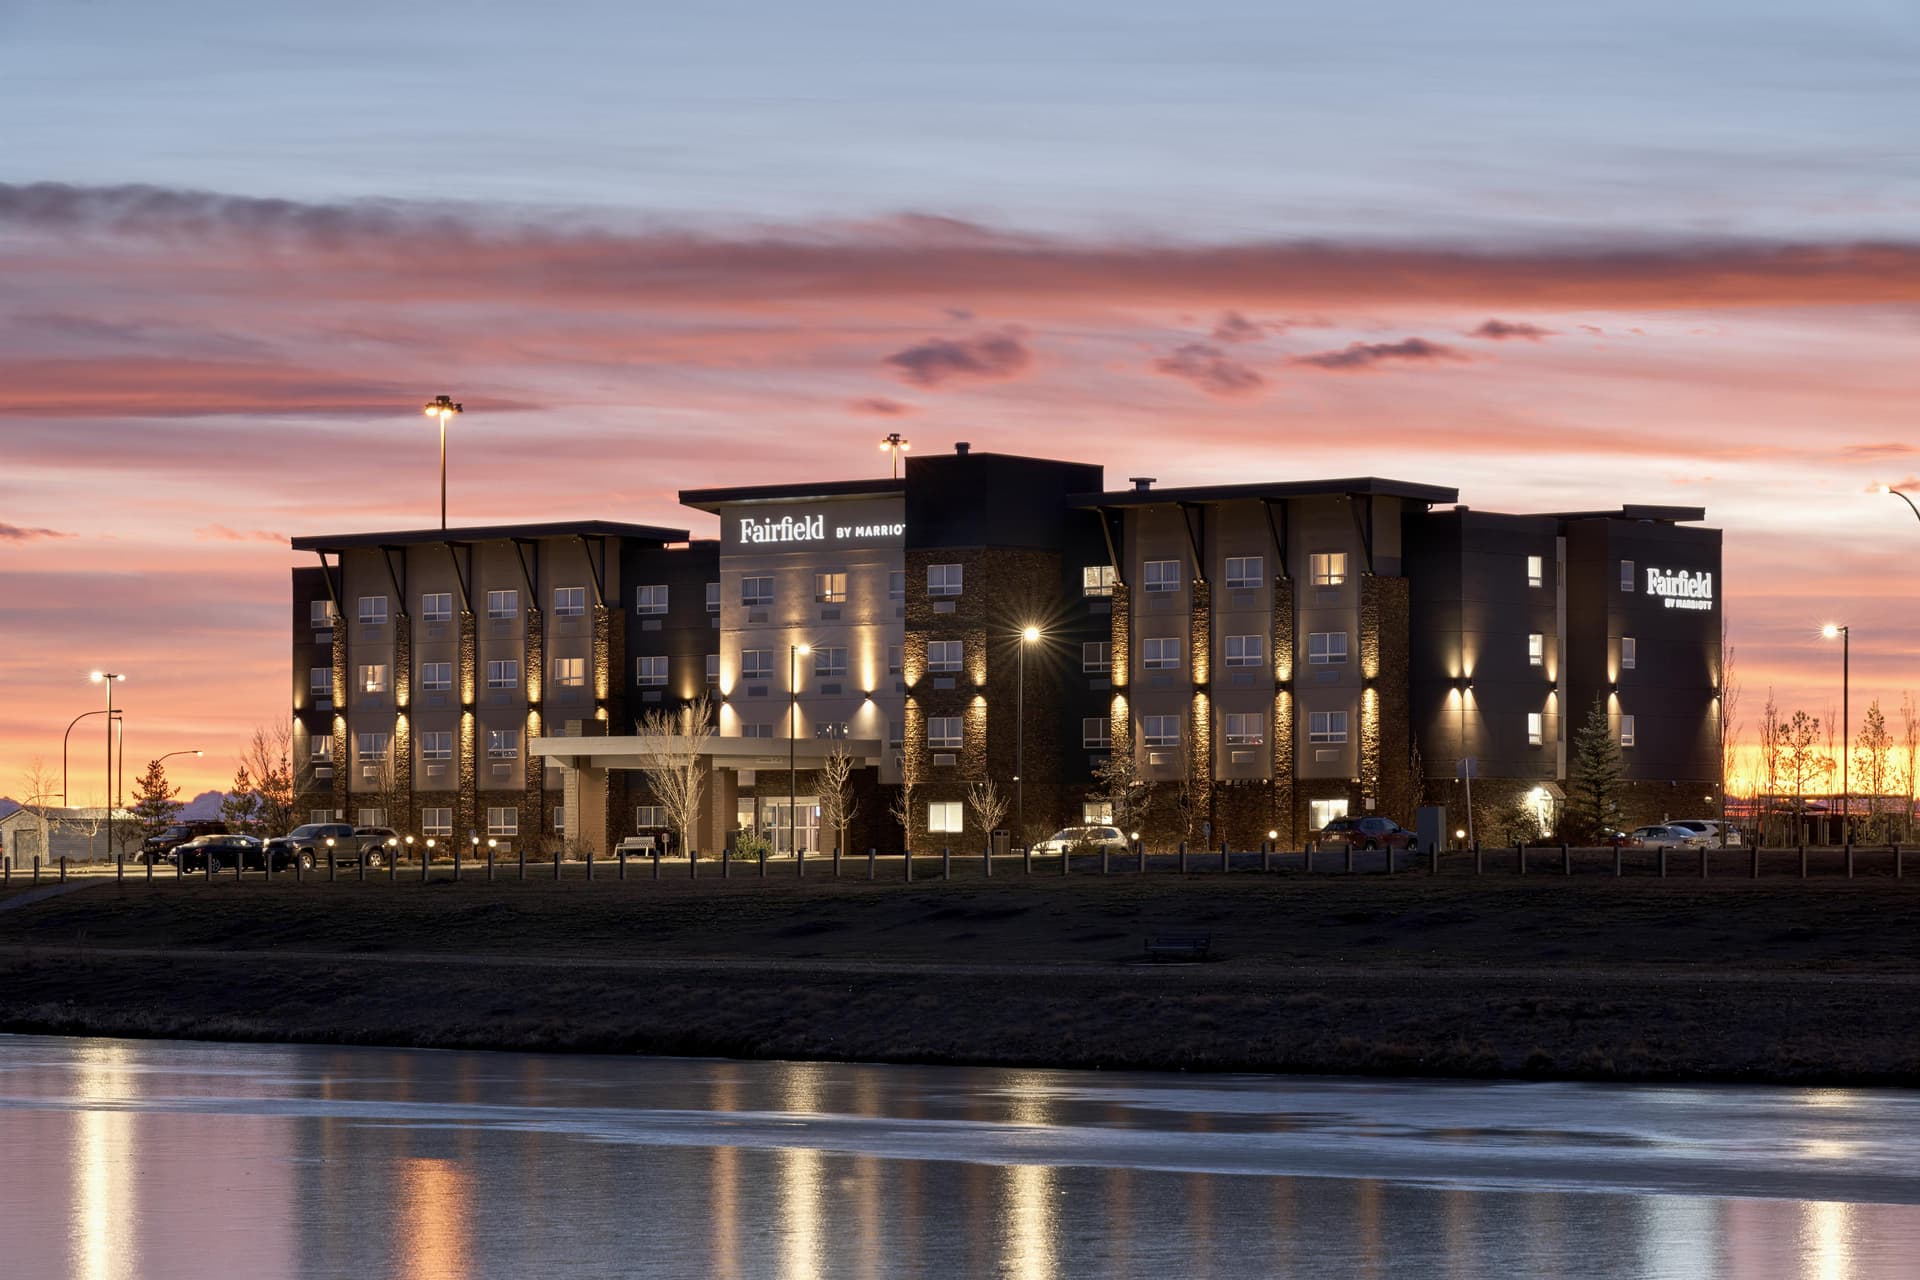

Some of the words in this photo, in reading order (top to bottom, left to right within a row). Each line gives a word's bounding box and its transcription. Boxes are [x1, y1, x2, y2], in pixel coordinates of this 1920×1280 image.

[740, 515, 824, 543] Fairfield
[836, 527, 851, 538] BY
[855, 524, 906, 537] MARRIO
[1646, 568, 1712, 598] Fairfield
